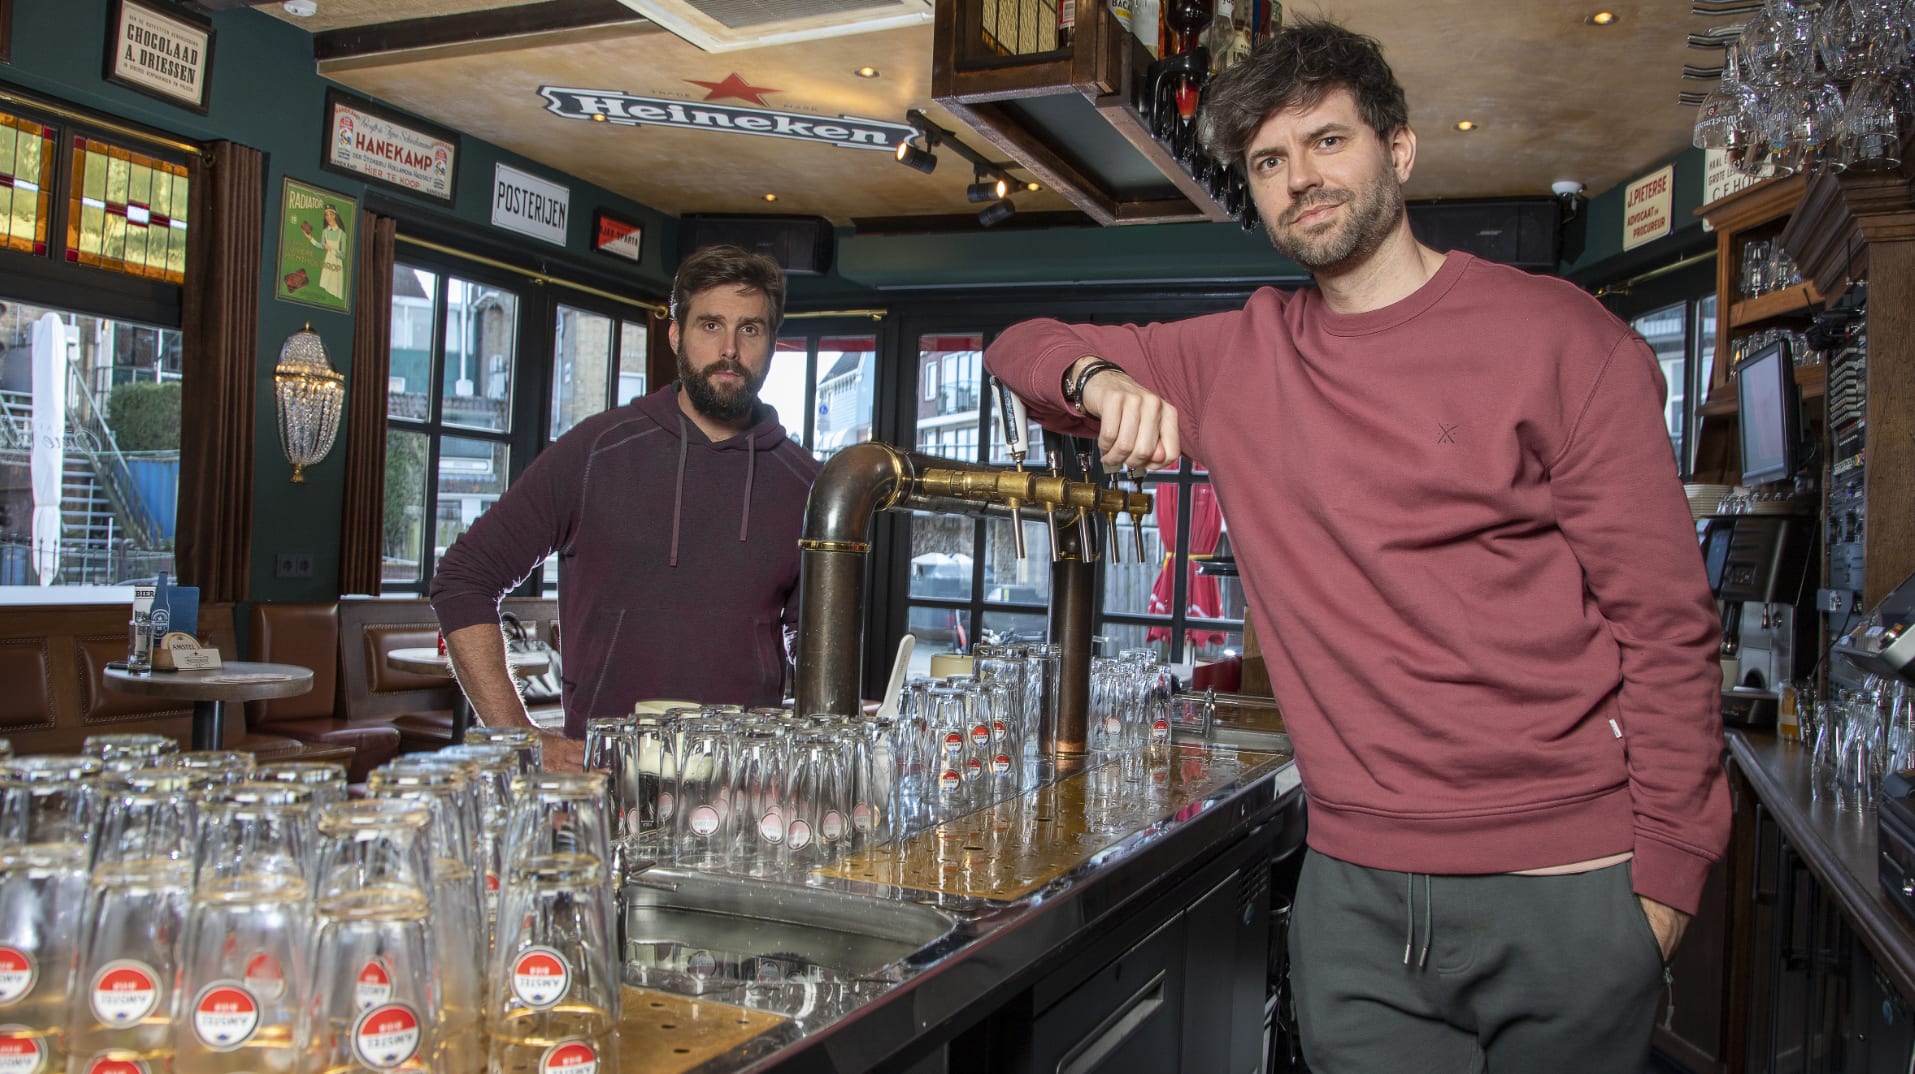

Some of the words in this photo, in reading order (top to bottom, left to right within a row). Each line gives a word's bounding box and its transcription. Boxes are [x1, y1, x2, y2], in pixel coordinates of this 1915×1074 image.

[127, 23, 198, 66] CHOCOLAAD
[125, 44, 136, 63] A.
[139, 48, 196, 84] DRIESSEN
[571, 94, 889, 145] Heineken
[355, 132, 433, 172] HANEKAMP
[364, 163, 383, 178] HIER
[387, 172, 397, 180] TE
[400, 175, 420, 188] KOOP
[289, 190, 323, 209] RADIATOR
[497, 180, 566, 230] POSTERIJEN
[1626, 205, 1655, 227] ADVOCAAT
[1633, 217, 1666, 240] PROCUREUR
[135, 590, 155, 598] BIER
[172, 643, 196, 651] AMSTEL
[520, 978, 561, 988] AMSTEL
